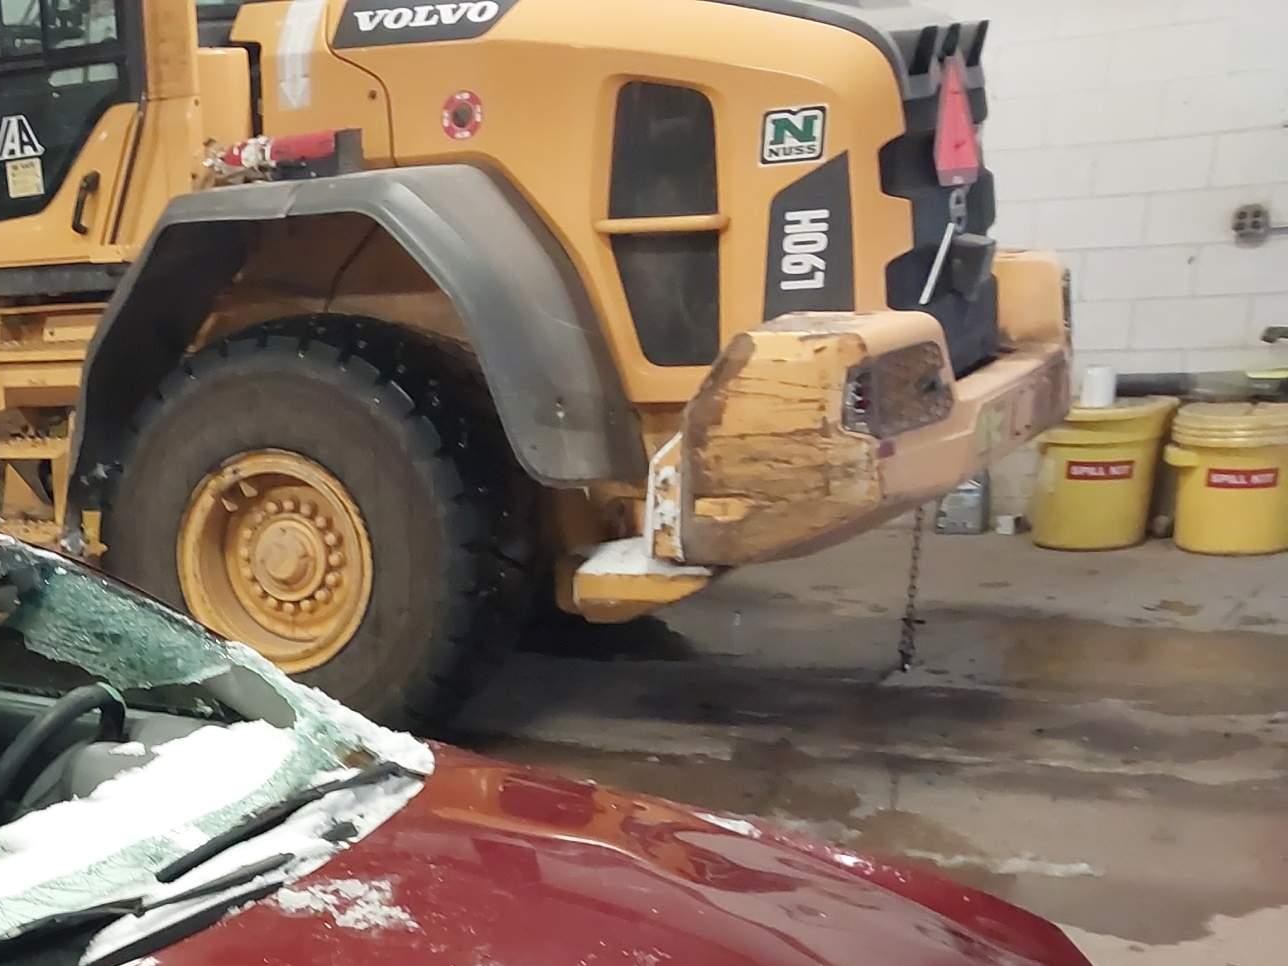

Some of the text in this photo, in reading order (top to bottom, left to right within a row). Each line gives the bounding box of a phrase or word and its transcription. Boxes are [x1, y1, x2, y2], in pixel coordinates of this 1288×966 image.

[353, 1, 499, 32] VOLVO
[769, 114, 818, 146] N
[768, 144, 817, 158] NUSS
